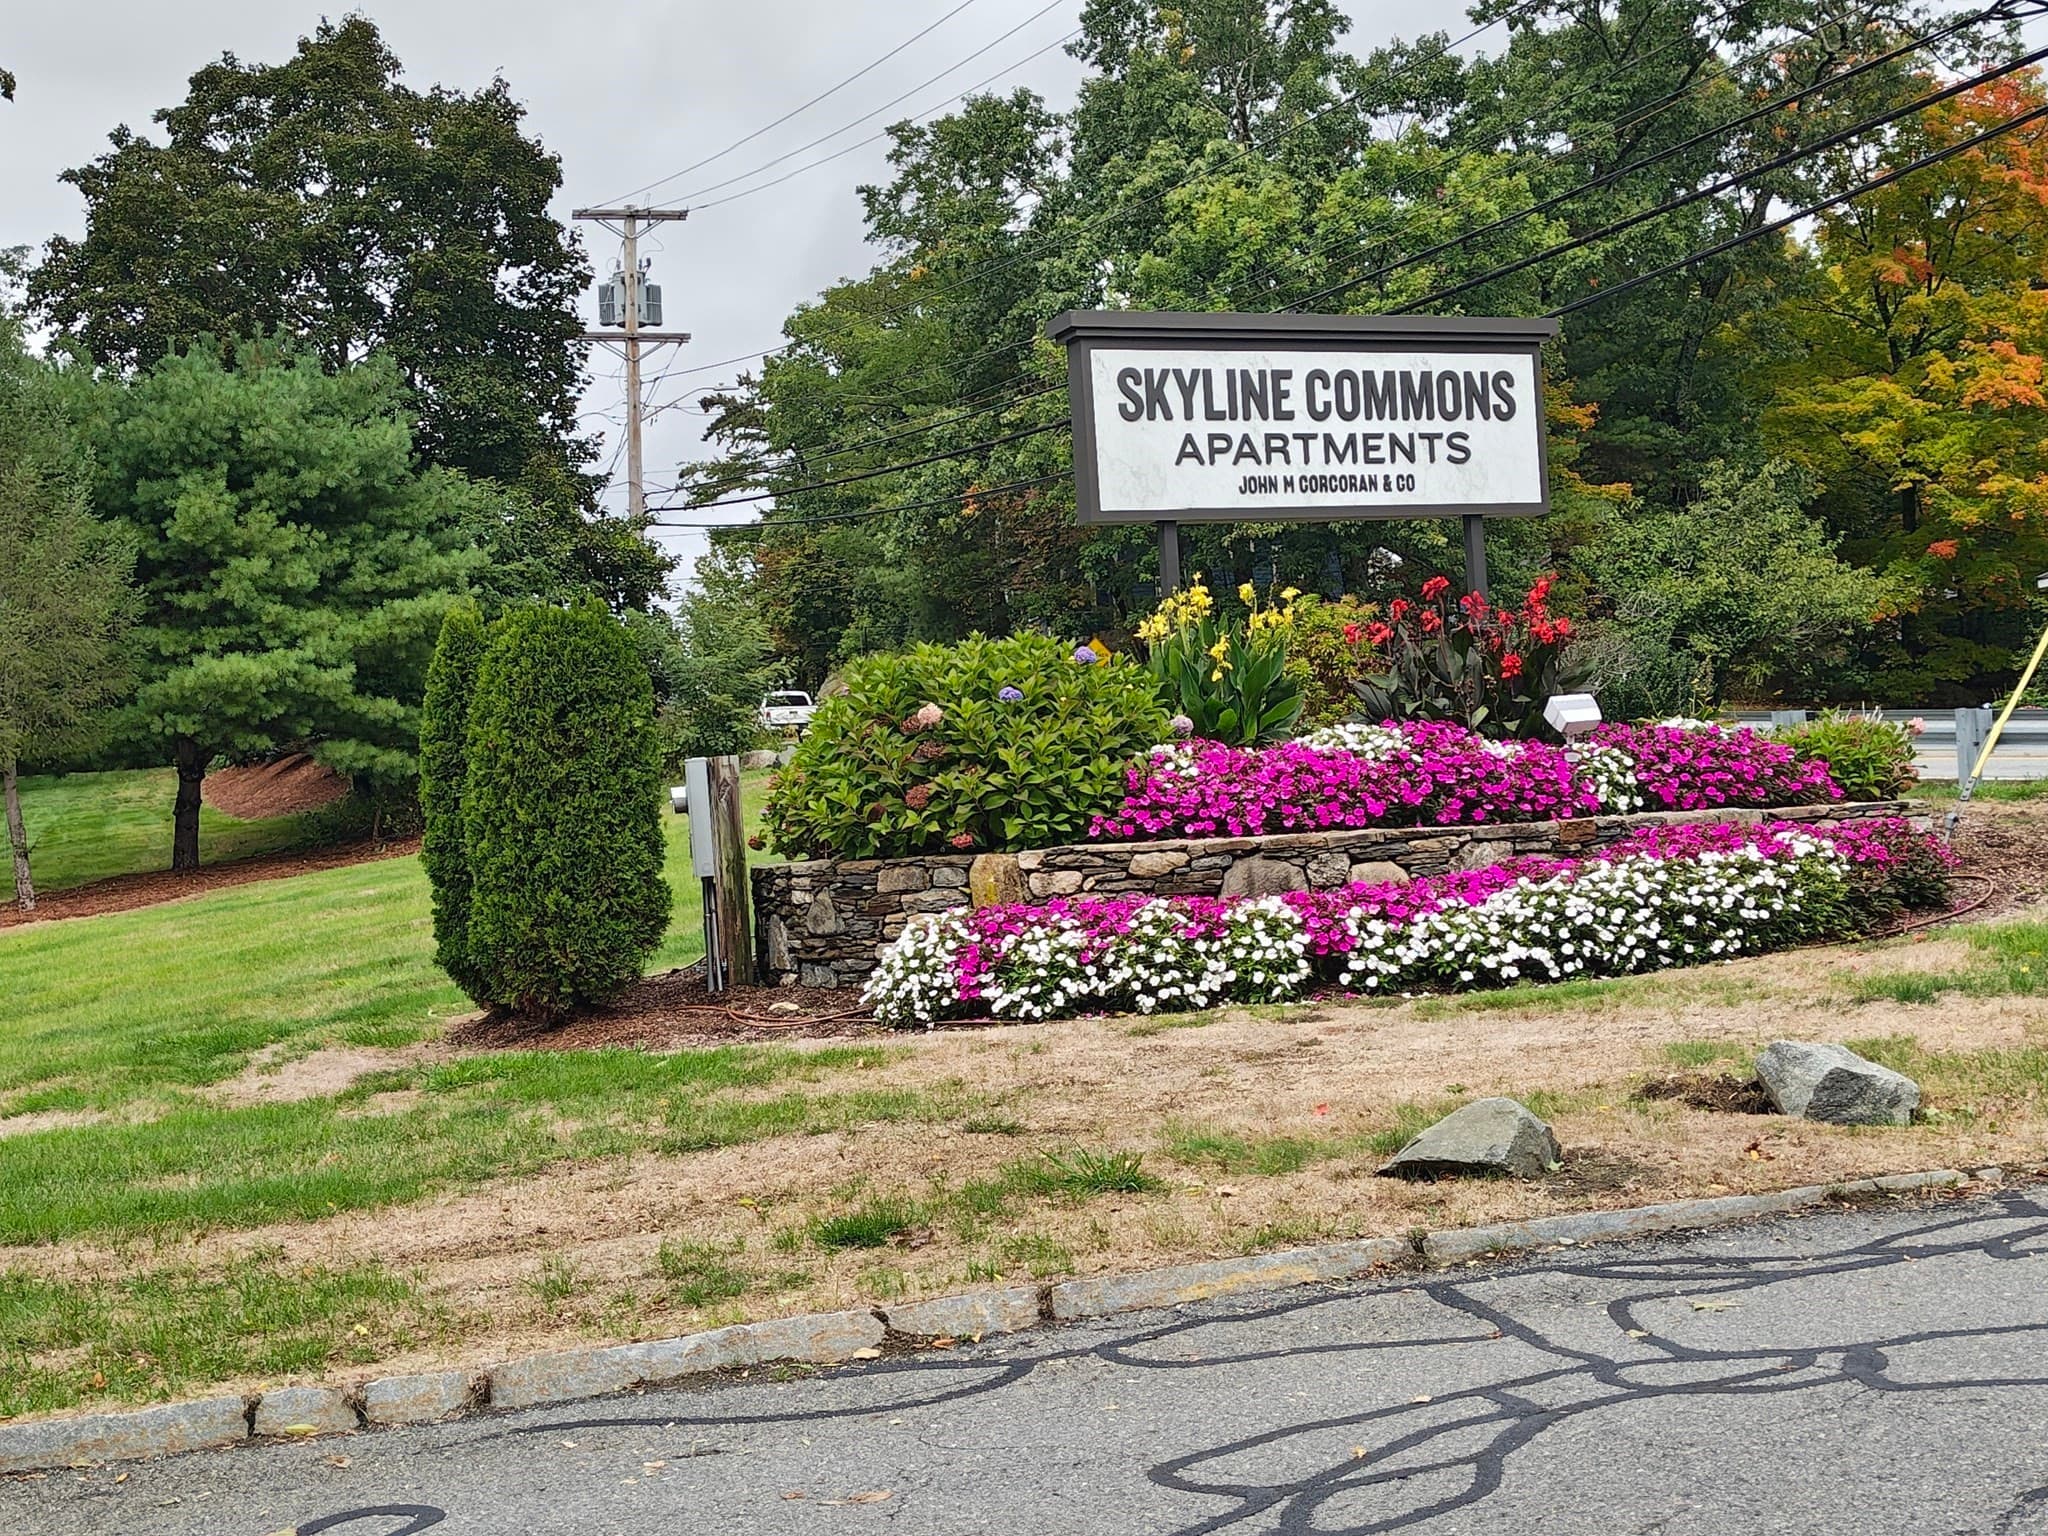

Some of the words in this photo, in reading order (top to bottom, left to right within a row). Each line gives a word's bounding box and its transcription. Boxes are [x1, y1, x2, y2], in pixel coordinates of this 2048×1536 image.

[1117, 368, 1295, 423] SKYLINE
[1305, 369, 1517, 422] COMMONS
[1175, 432, 1472, 465] APARTMENTS
[1238, 475, 1278, 495] JOHN
[1283, 475, 1295, 494] M
[1298, 474, 1378, 494] CORCORAN
[1383, 474, 1393, 493] &
[1396, 473, 1416, 493] CO
